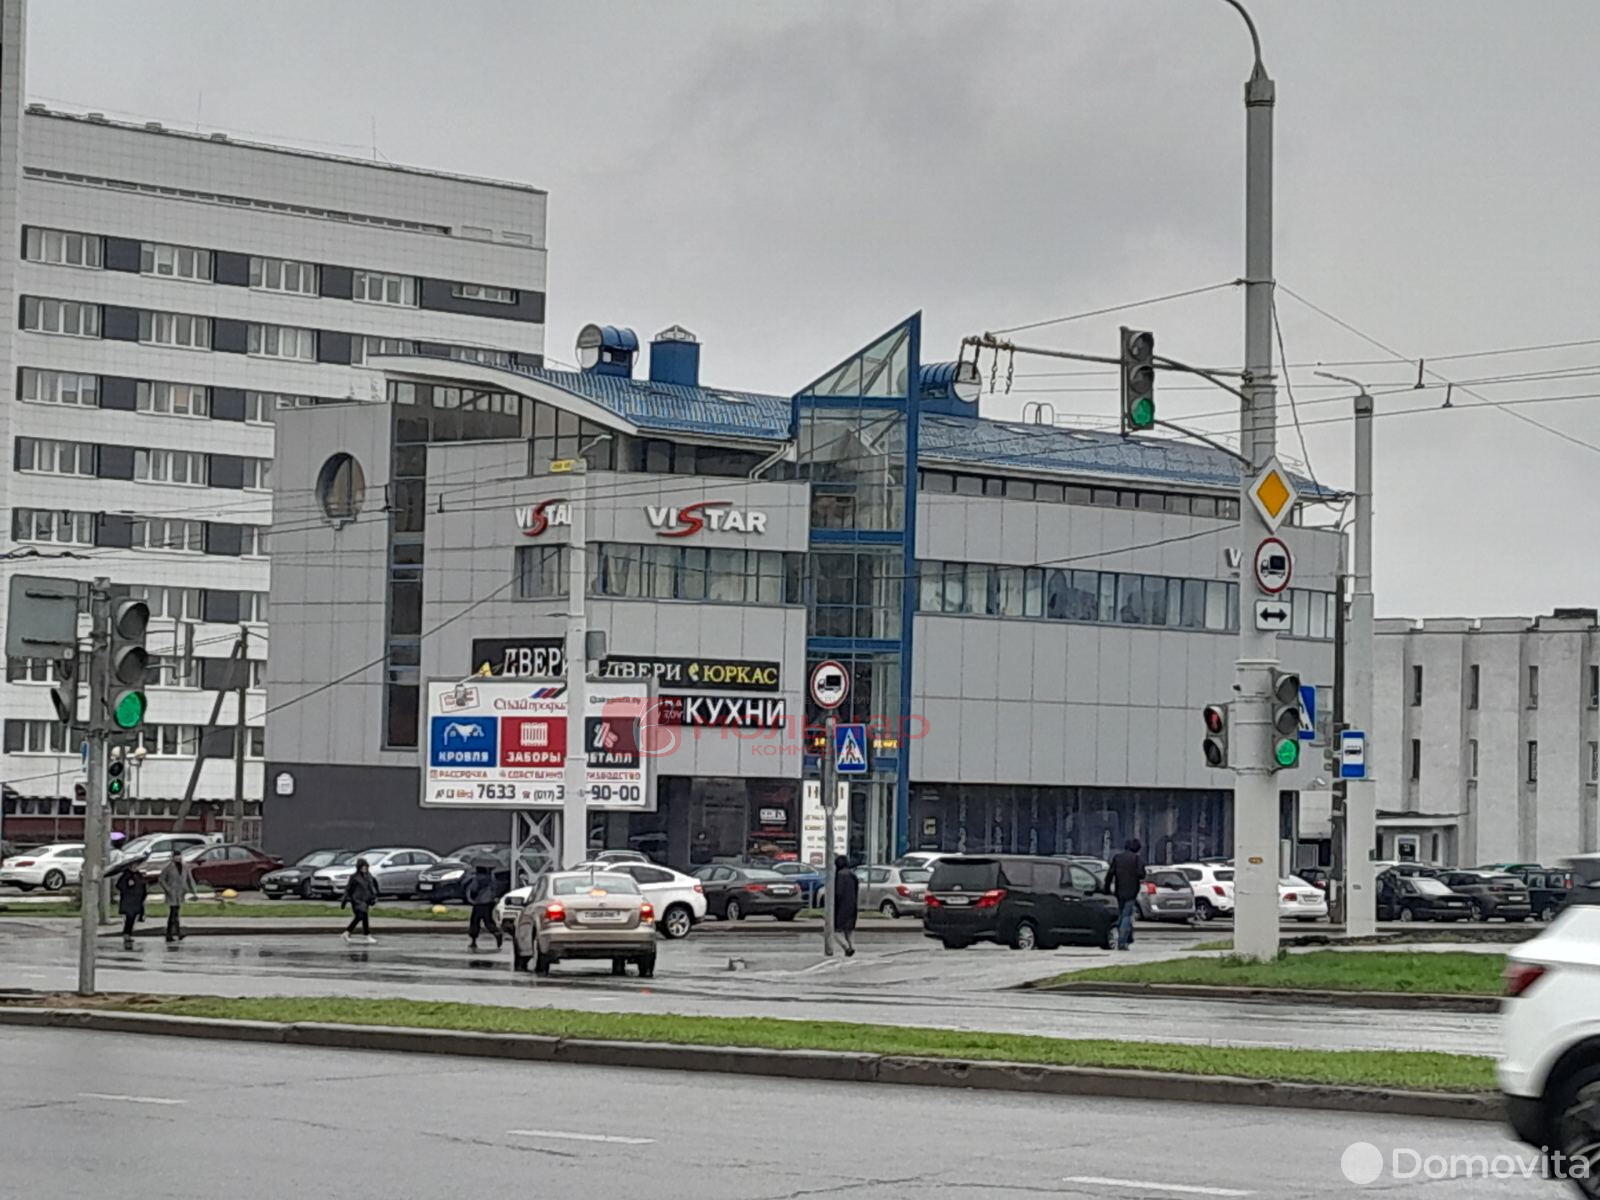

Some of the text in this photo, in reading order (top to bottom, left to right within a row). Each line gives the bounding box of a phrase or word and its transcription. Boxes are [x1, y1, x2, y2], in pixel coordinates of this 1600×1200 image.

[515, 498, 572, 537] VISTA
[645, 501, 768, 538] VISTAR
[604, 660, 777, 685] ДВЕРИ ЮРКАС
[686, 696, 786, 728] КУХНИ
[438, 751, 489, 763] КРОВЛЯ
[506, 751, 561, 763] ЗАБОРЫ
[585, 752, 633, 764] ЕТАЛЛ
[477, 783, 516, 799] 7633
[533, 789, 554, 801] (017)
